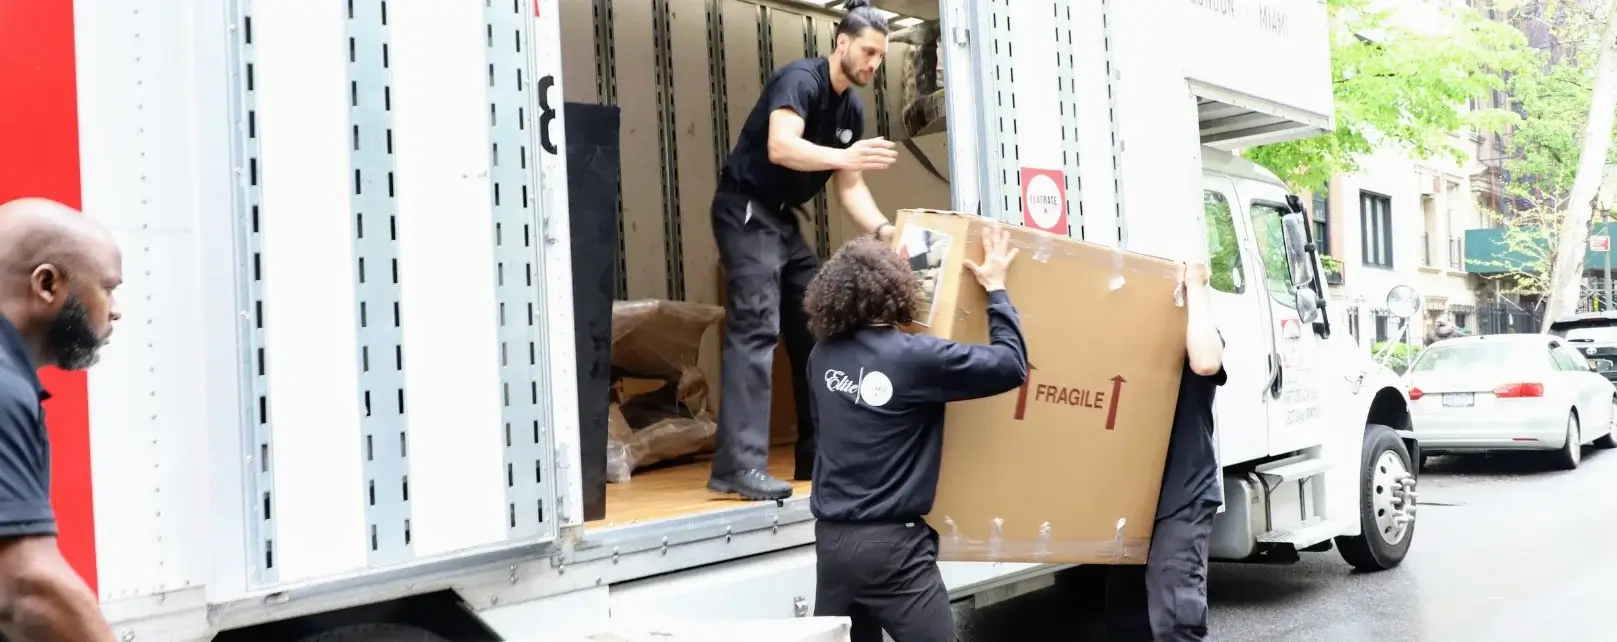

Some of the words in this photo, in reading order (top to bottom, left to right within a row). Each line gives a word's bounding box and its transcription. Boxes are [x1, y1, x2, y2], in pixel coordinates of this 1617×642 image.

[1259, 4, 1289, 38] MIAMI
[824, 369, 859, 394] Elite
[1035, 383, 1105, 409] FRAGILE
